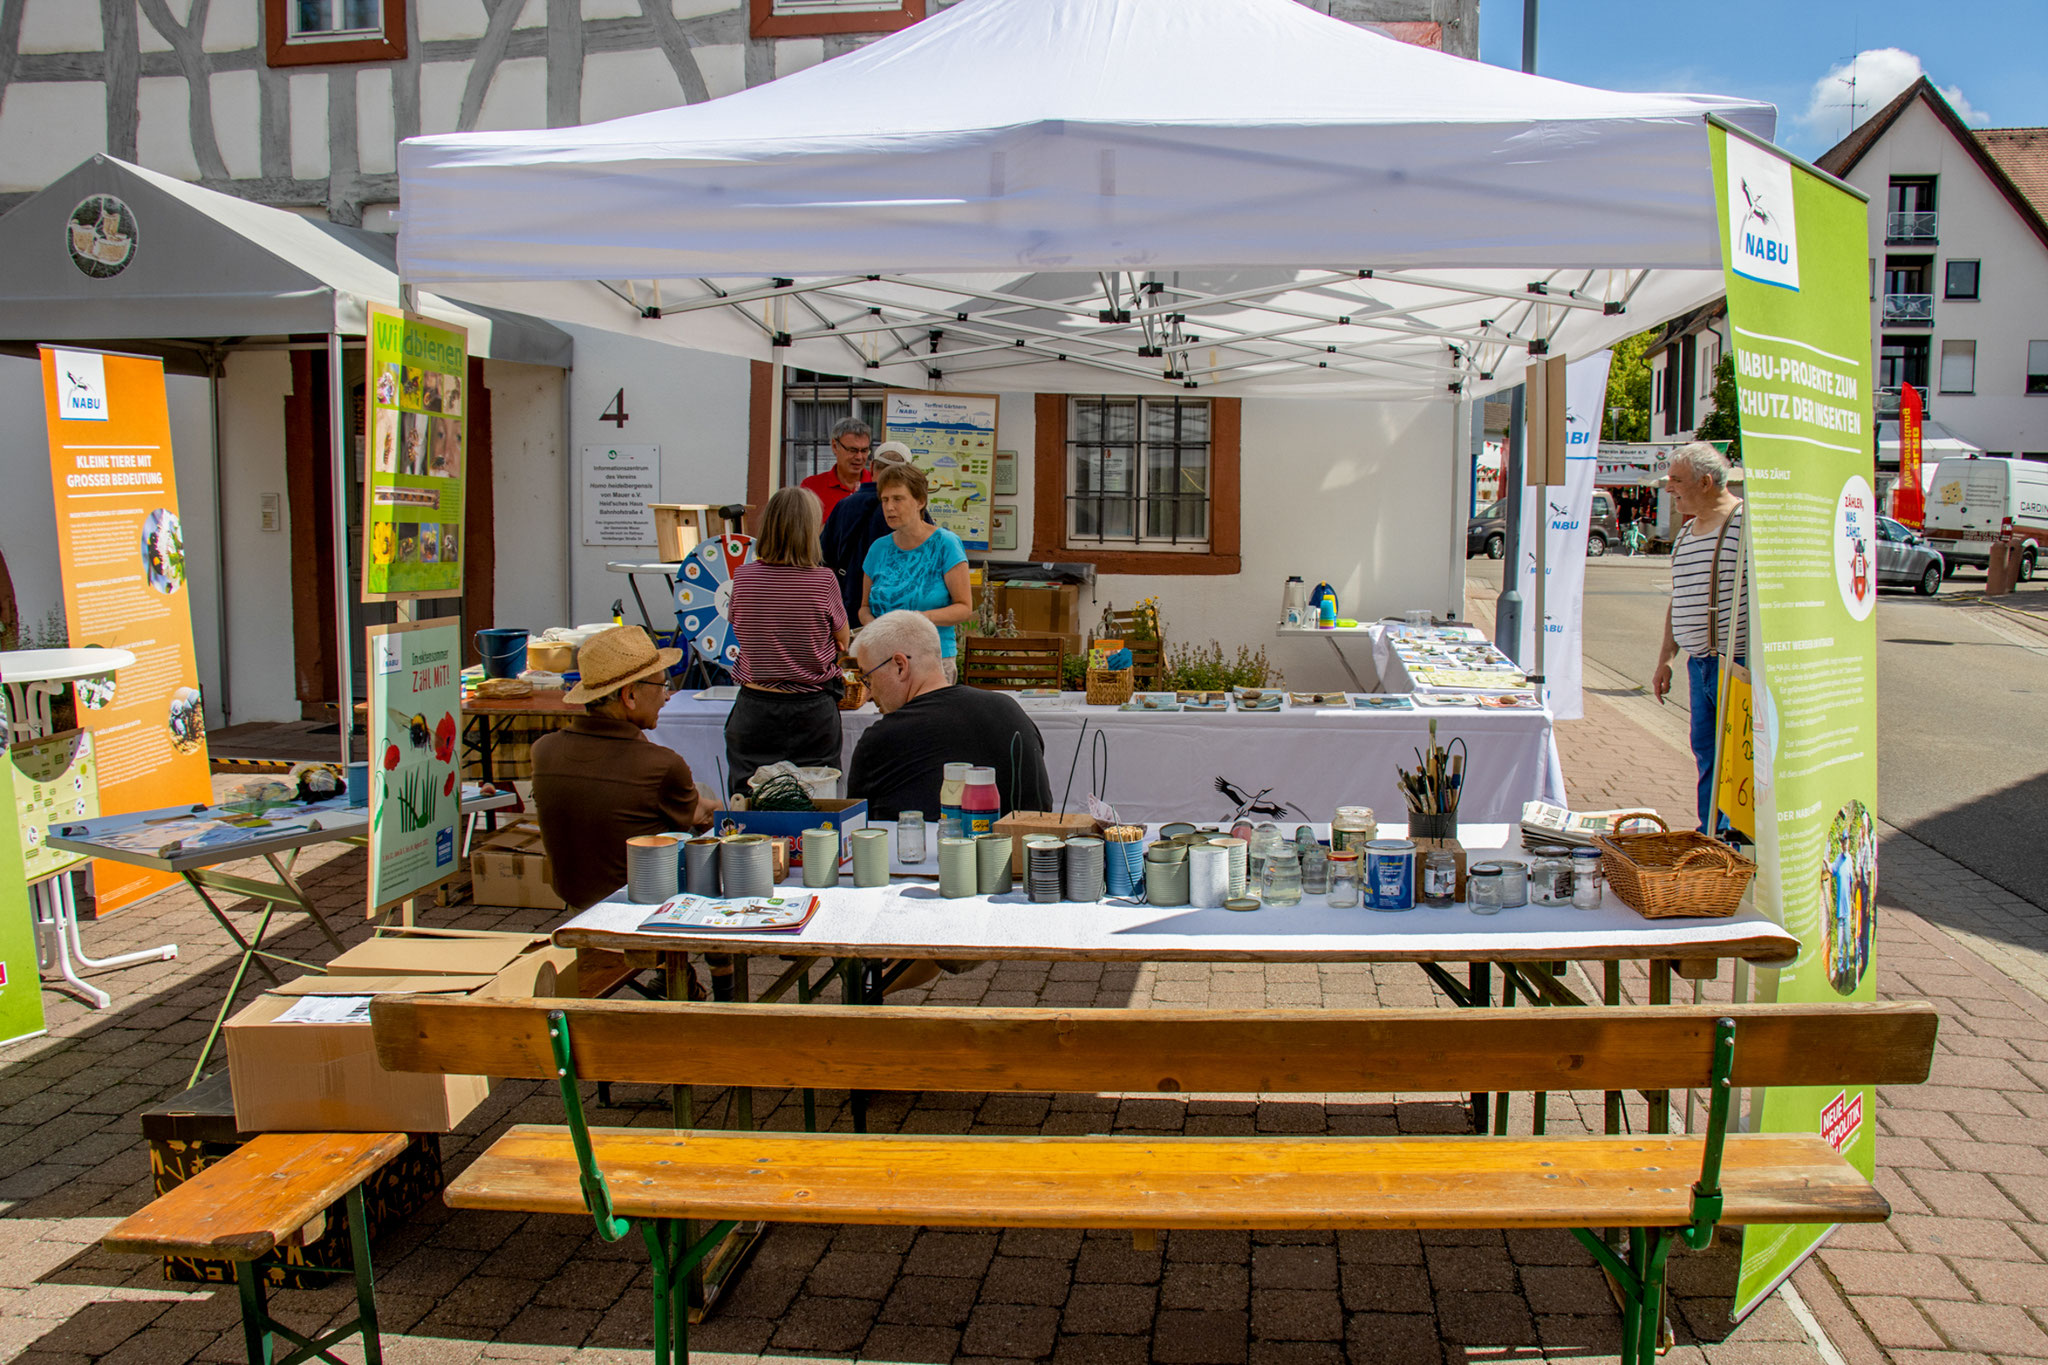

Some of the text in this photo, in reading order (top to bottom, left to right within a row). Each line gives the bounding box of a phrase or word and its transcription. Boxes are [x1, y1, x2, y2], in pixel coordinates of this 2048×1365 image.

[1745, 232, 1788, 265] NABU
[377, 321, 462, 367] Wildbienen
[1738, 348, 1858, 401] NABU-PROJEKTE ZUM
[72, 397, 101, 409] NABU
[599, 387, 629, 428] 4
[1791, 396, 1815, 424] DER
[1815, 401, 1861, 435] INSEKTEN
[76, 455, 152, 469] KLEINE TIERE MIT
[1755, 469, 1769, 480] WAS
[1770, 467, 1791, 480] ZÄHLT
[66, 472, 163, 487] GROSSER BEDEUTUNG
[1777, 810, 1794, 822] DER
[1823, 1099, 1843, 1133] NEUE
